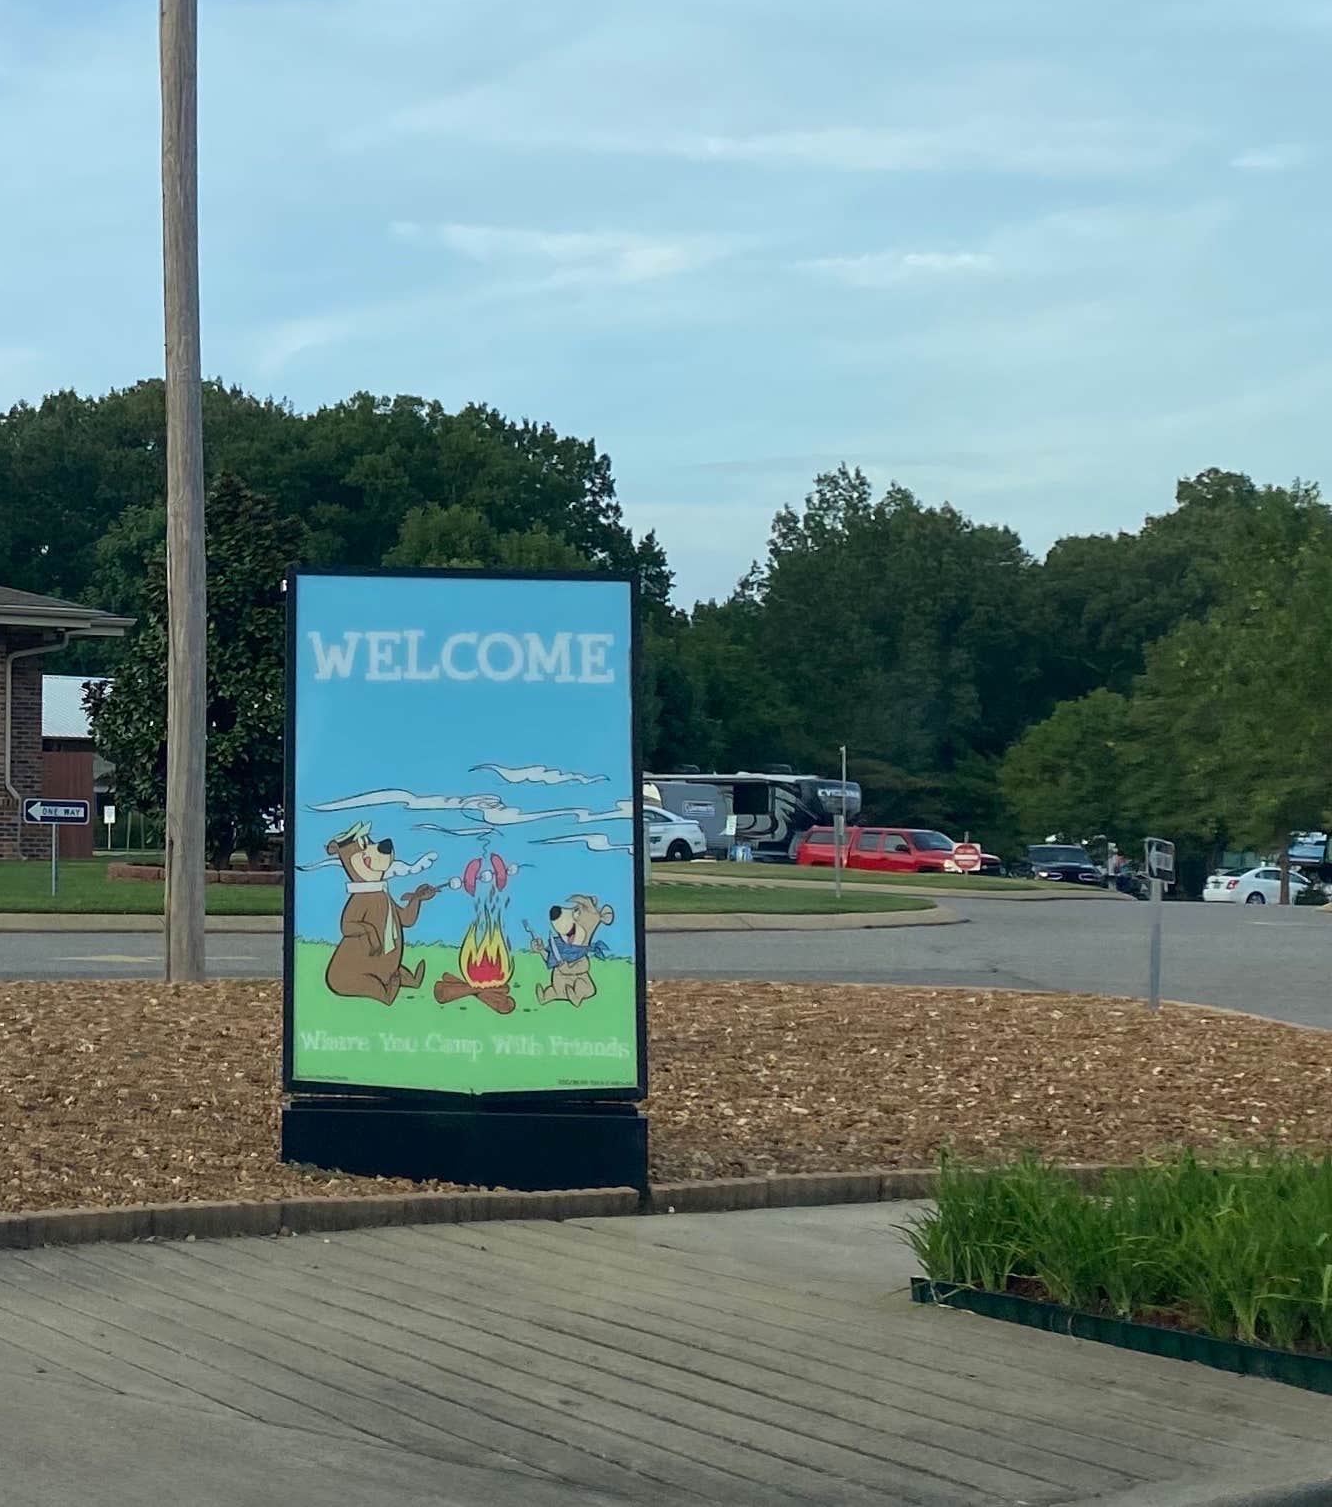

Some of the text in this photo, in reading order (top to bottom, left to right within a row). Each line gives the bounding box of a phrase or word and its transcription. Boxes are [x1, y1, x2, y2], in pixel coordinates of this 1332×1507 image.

[307, 630, 615, 683] WELCOME
[42, 807, 81, 816] ONE WAY
[379, 1032, 414, 1053] You
[425, 1032, 483, 1061] Camp
